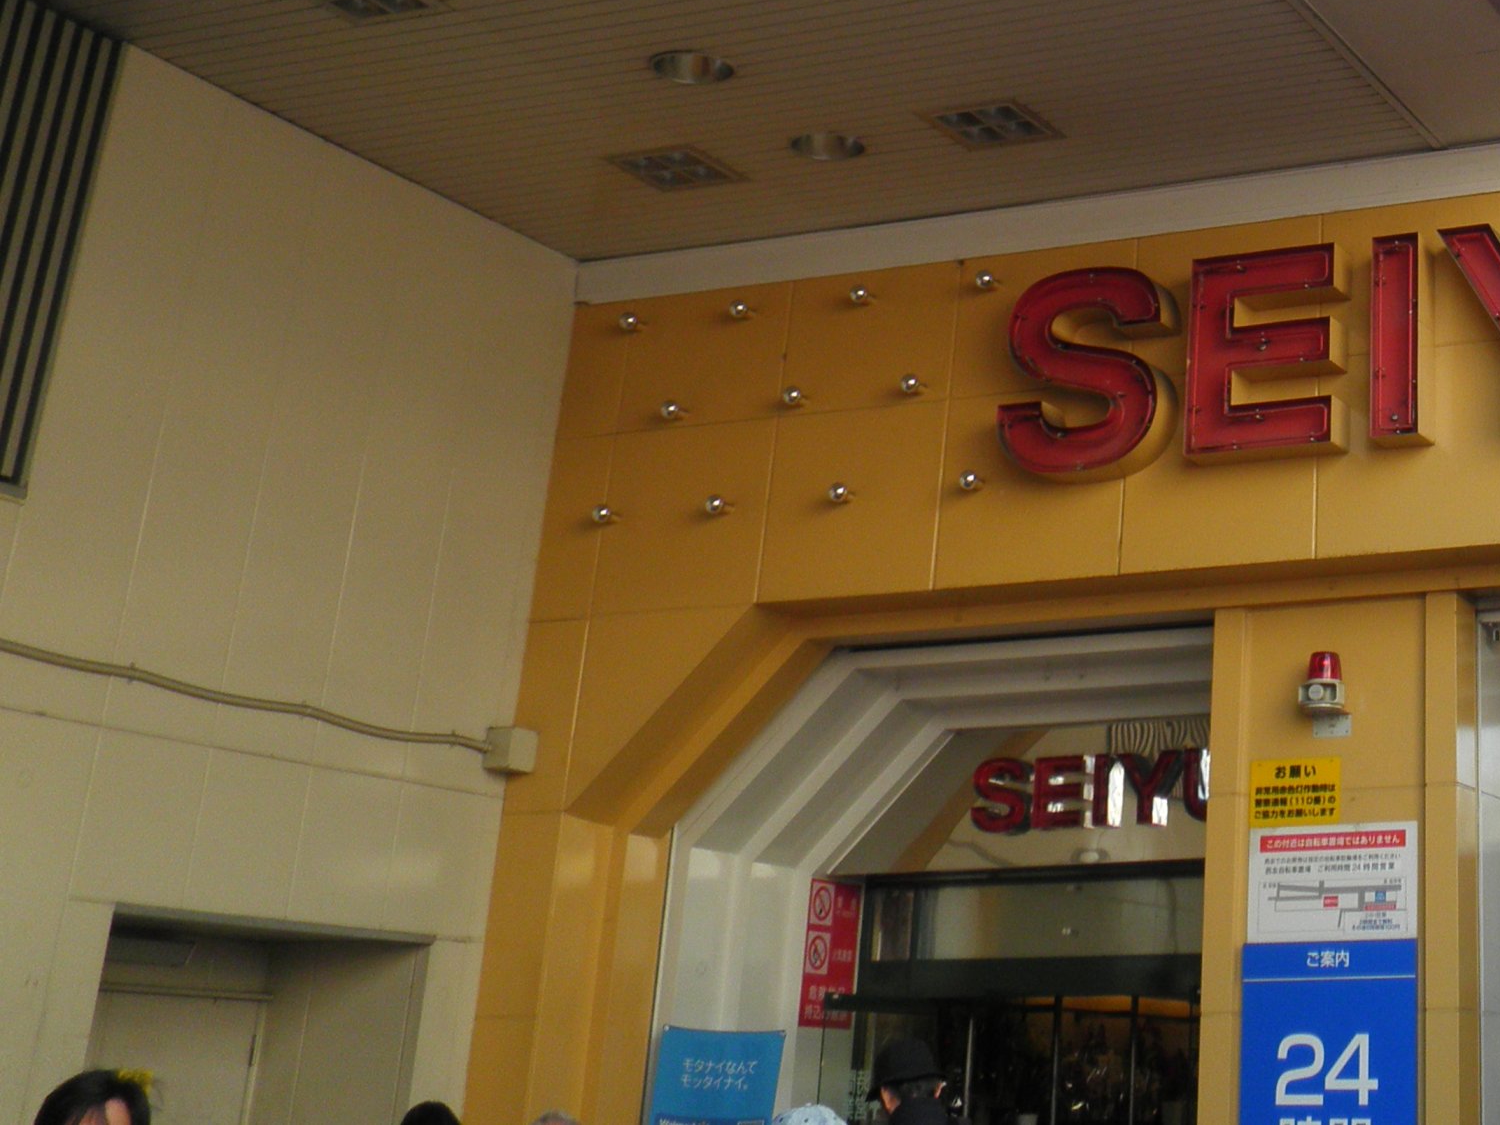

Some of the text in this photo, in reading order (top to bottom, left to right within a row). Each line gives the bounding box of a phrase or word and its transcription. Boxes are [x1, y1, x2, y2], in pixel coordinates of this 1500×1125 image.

[1274, 764, 1317, 780] お願い
[1306, 949, 1350, 968] ご案内
[1275, 1032, 1379, 1106] 24
